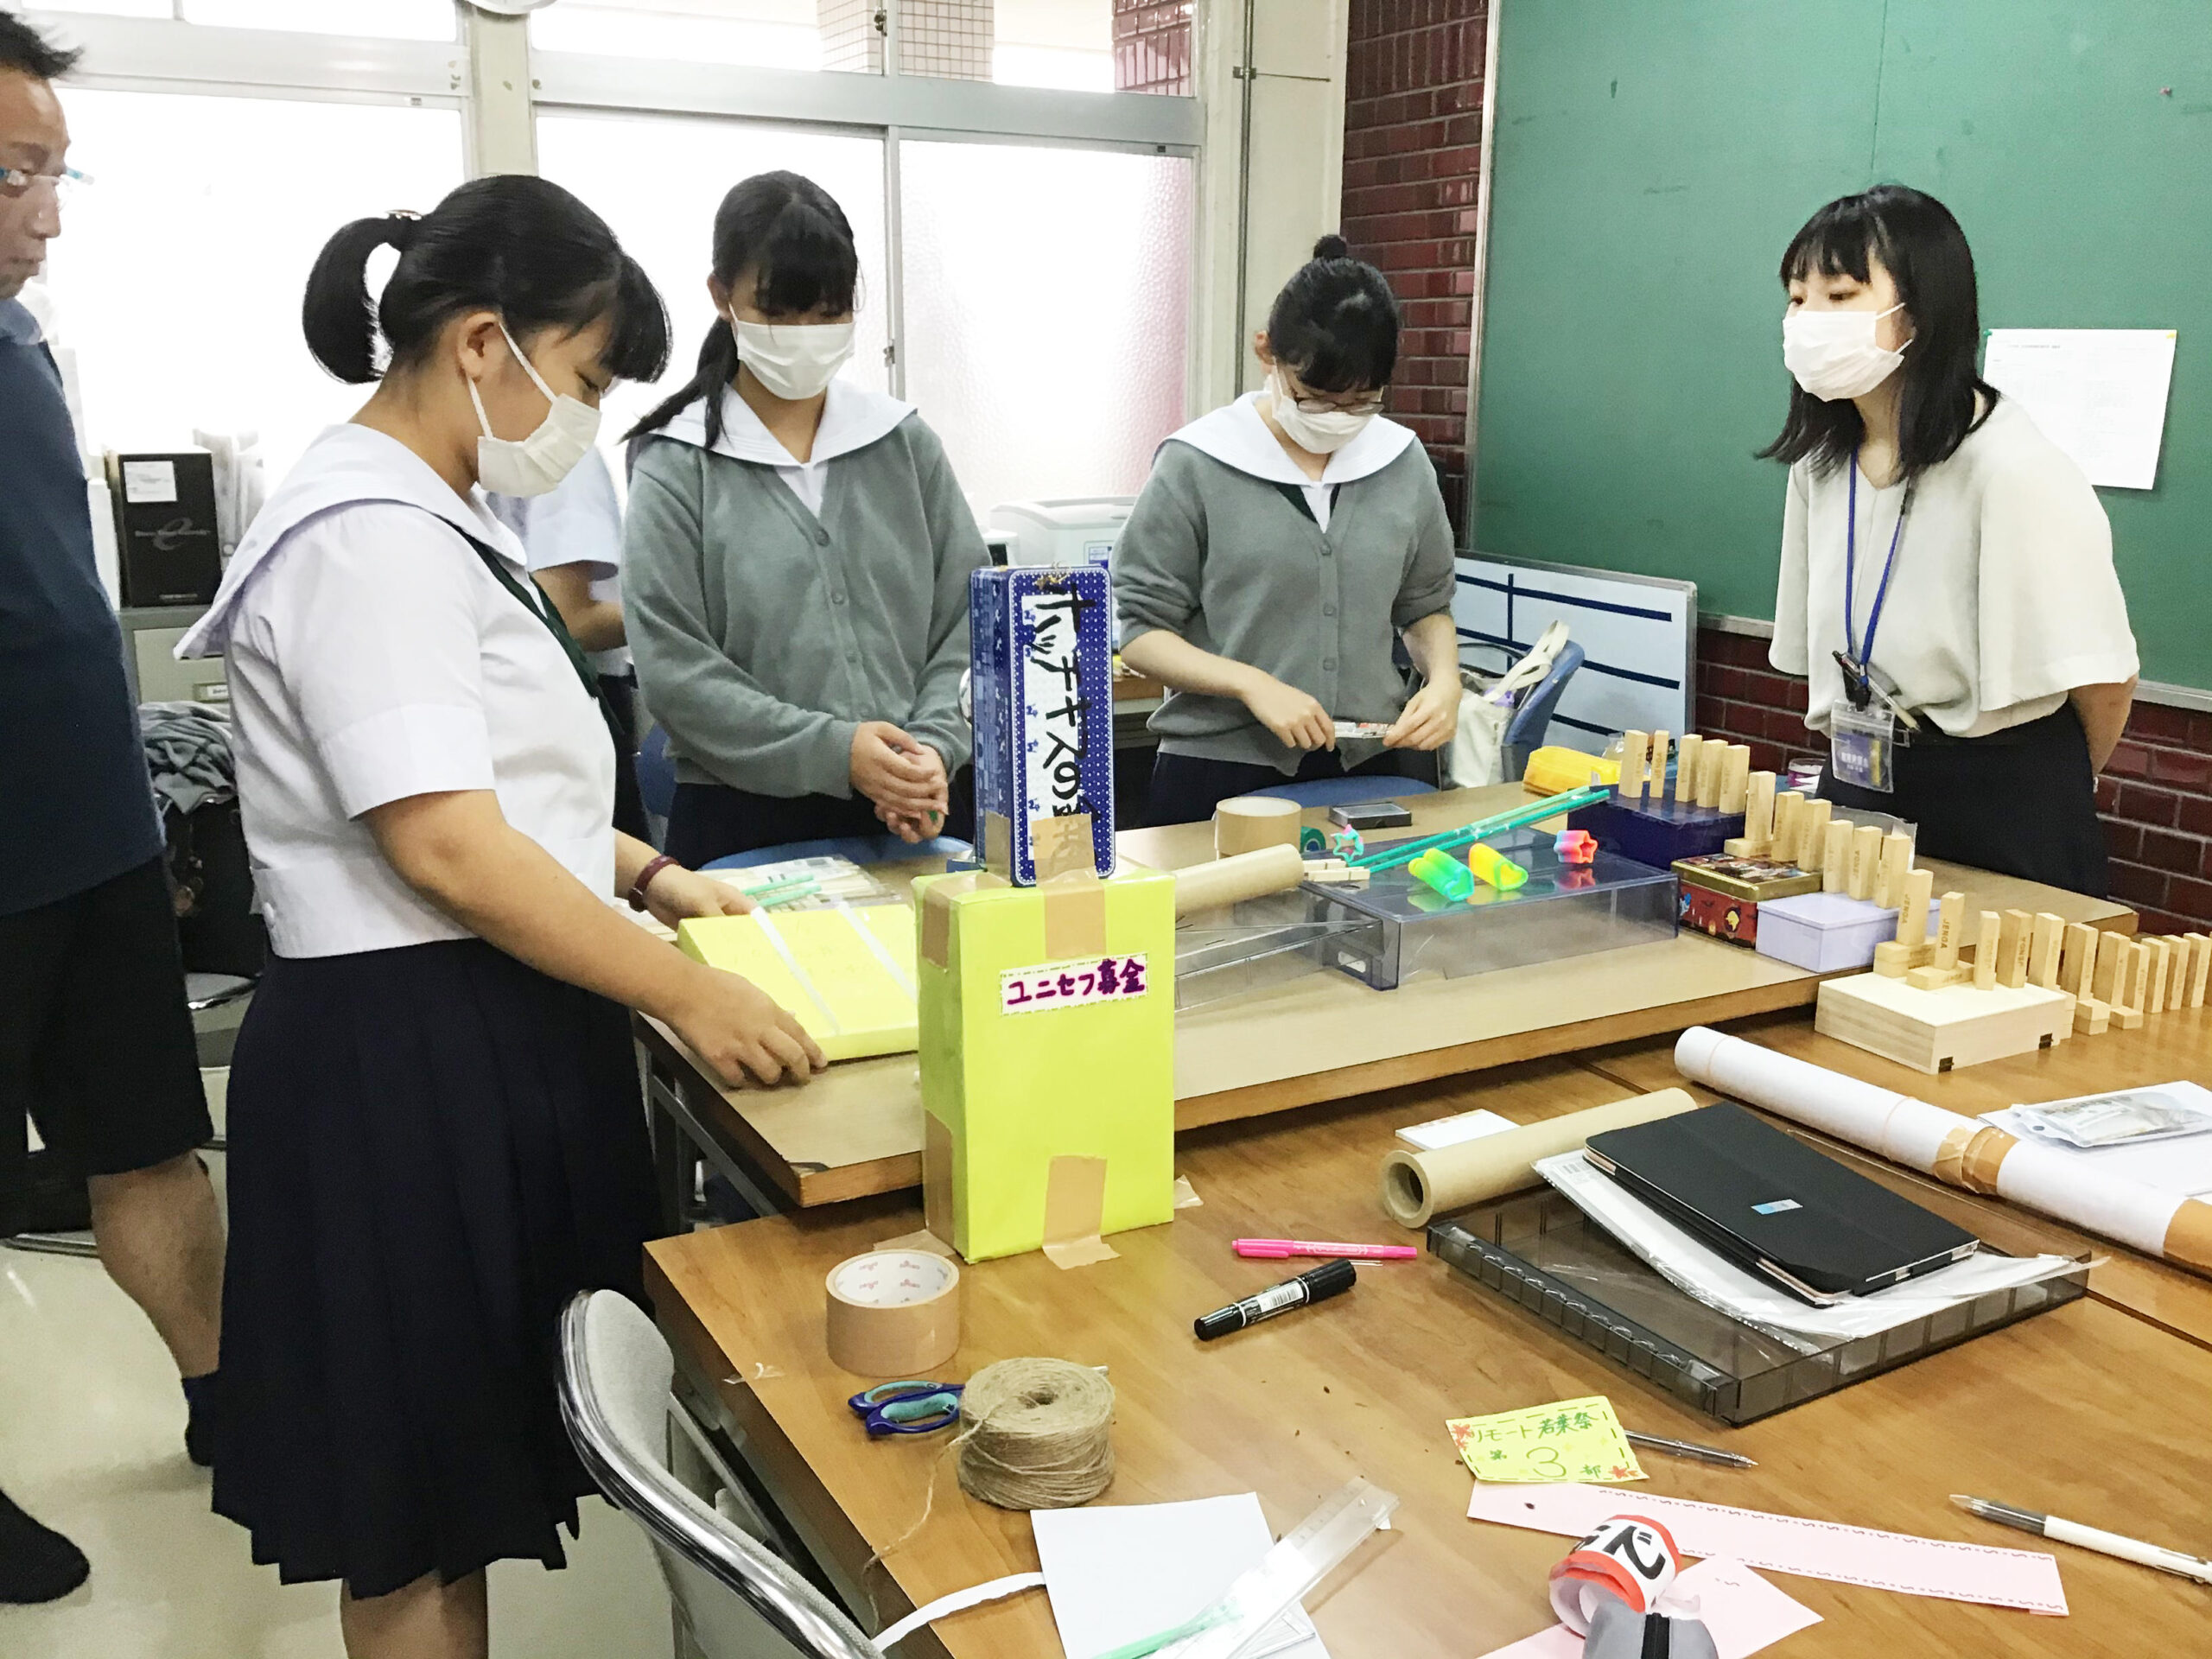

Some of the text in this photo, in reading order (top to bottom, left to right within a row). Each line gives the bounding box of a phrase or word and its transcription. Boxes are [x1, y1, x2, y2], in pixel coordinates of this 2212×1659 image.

[1902, 893, 1911, 924] JENGA
[1940, 918, 1950, 949] JENGA
[1007, 957, 1146, 1005] ユニセフ募金
